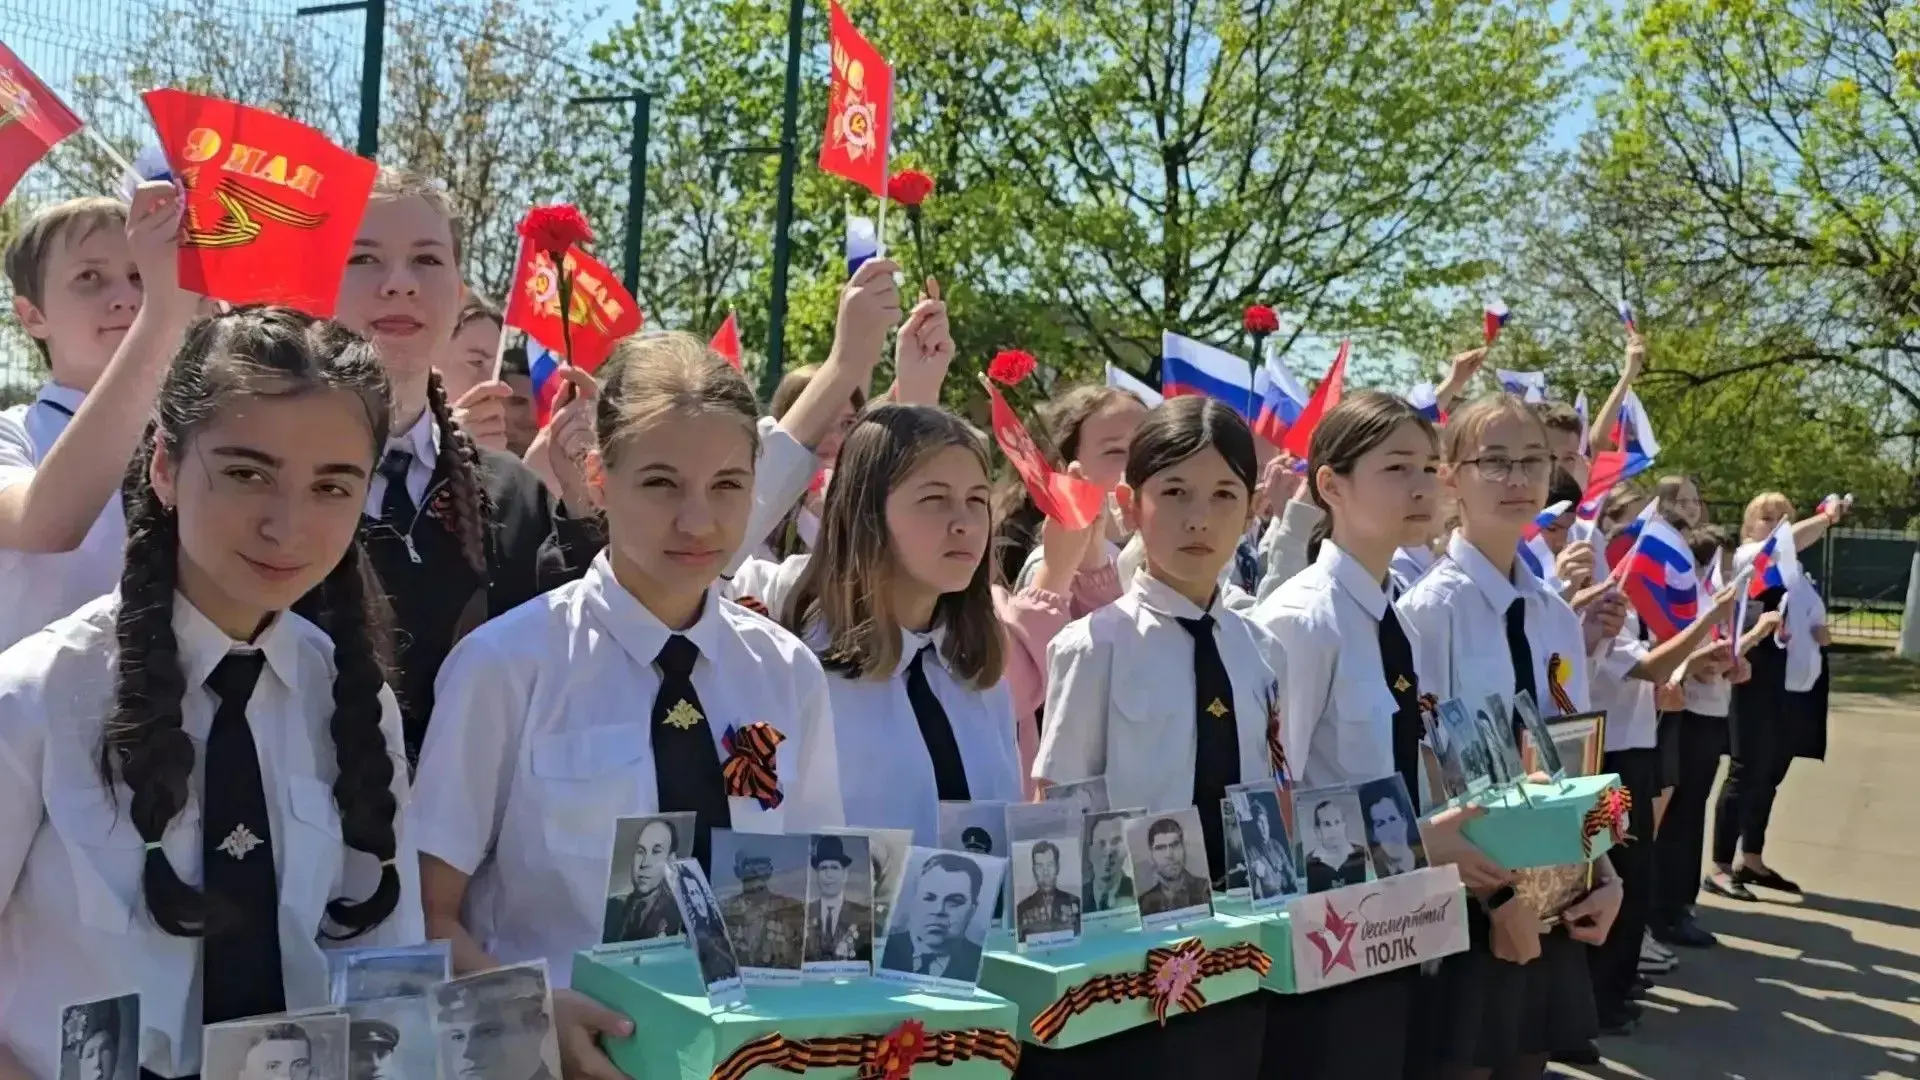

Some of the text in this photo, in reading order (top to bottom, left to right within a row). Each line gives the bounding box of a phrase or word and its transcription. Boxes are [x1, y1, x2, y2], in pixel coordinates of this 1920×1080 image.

[183, 127, 222, 162] 9
[220, 143, 325, 199] МАЯ
[1365, 936, 1418, 969] ПОЛК
